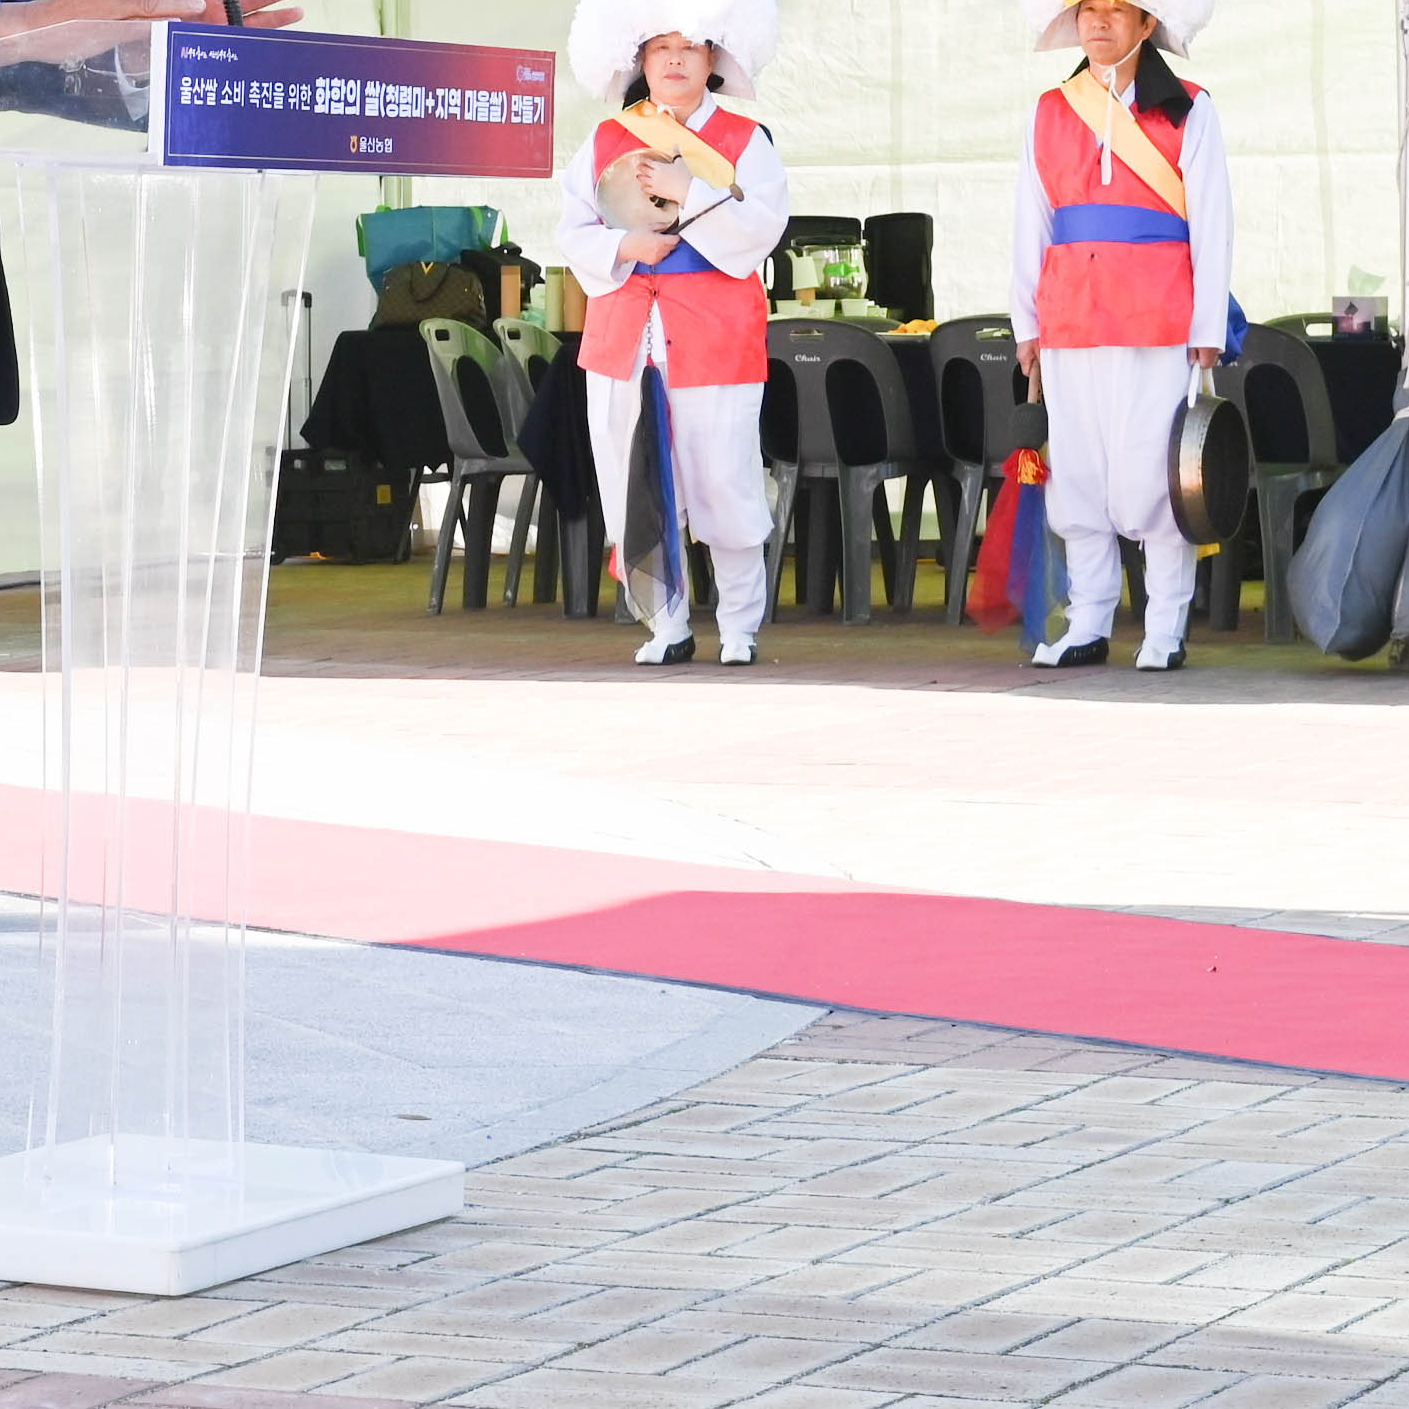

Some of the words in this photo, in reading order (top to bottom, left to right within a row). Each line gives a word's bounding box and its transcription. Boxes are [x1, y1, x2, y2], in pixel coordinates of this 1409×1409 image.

[180, 76, 218, 106] 울산쌀
[220, 79, 245, 107] 소비
[248, 80, 285, 110] 촉진을
[288, 83, 312, 111] 위한
[314, 76, 361, 116] 화합의
[464, 90, 508, 124] 마을쌀)
[511, 94, 545, 125] 만들기
